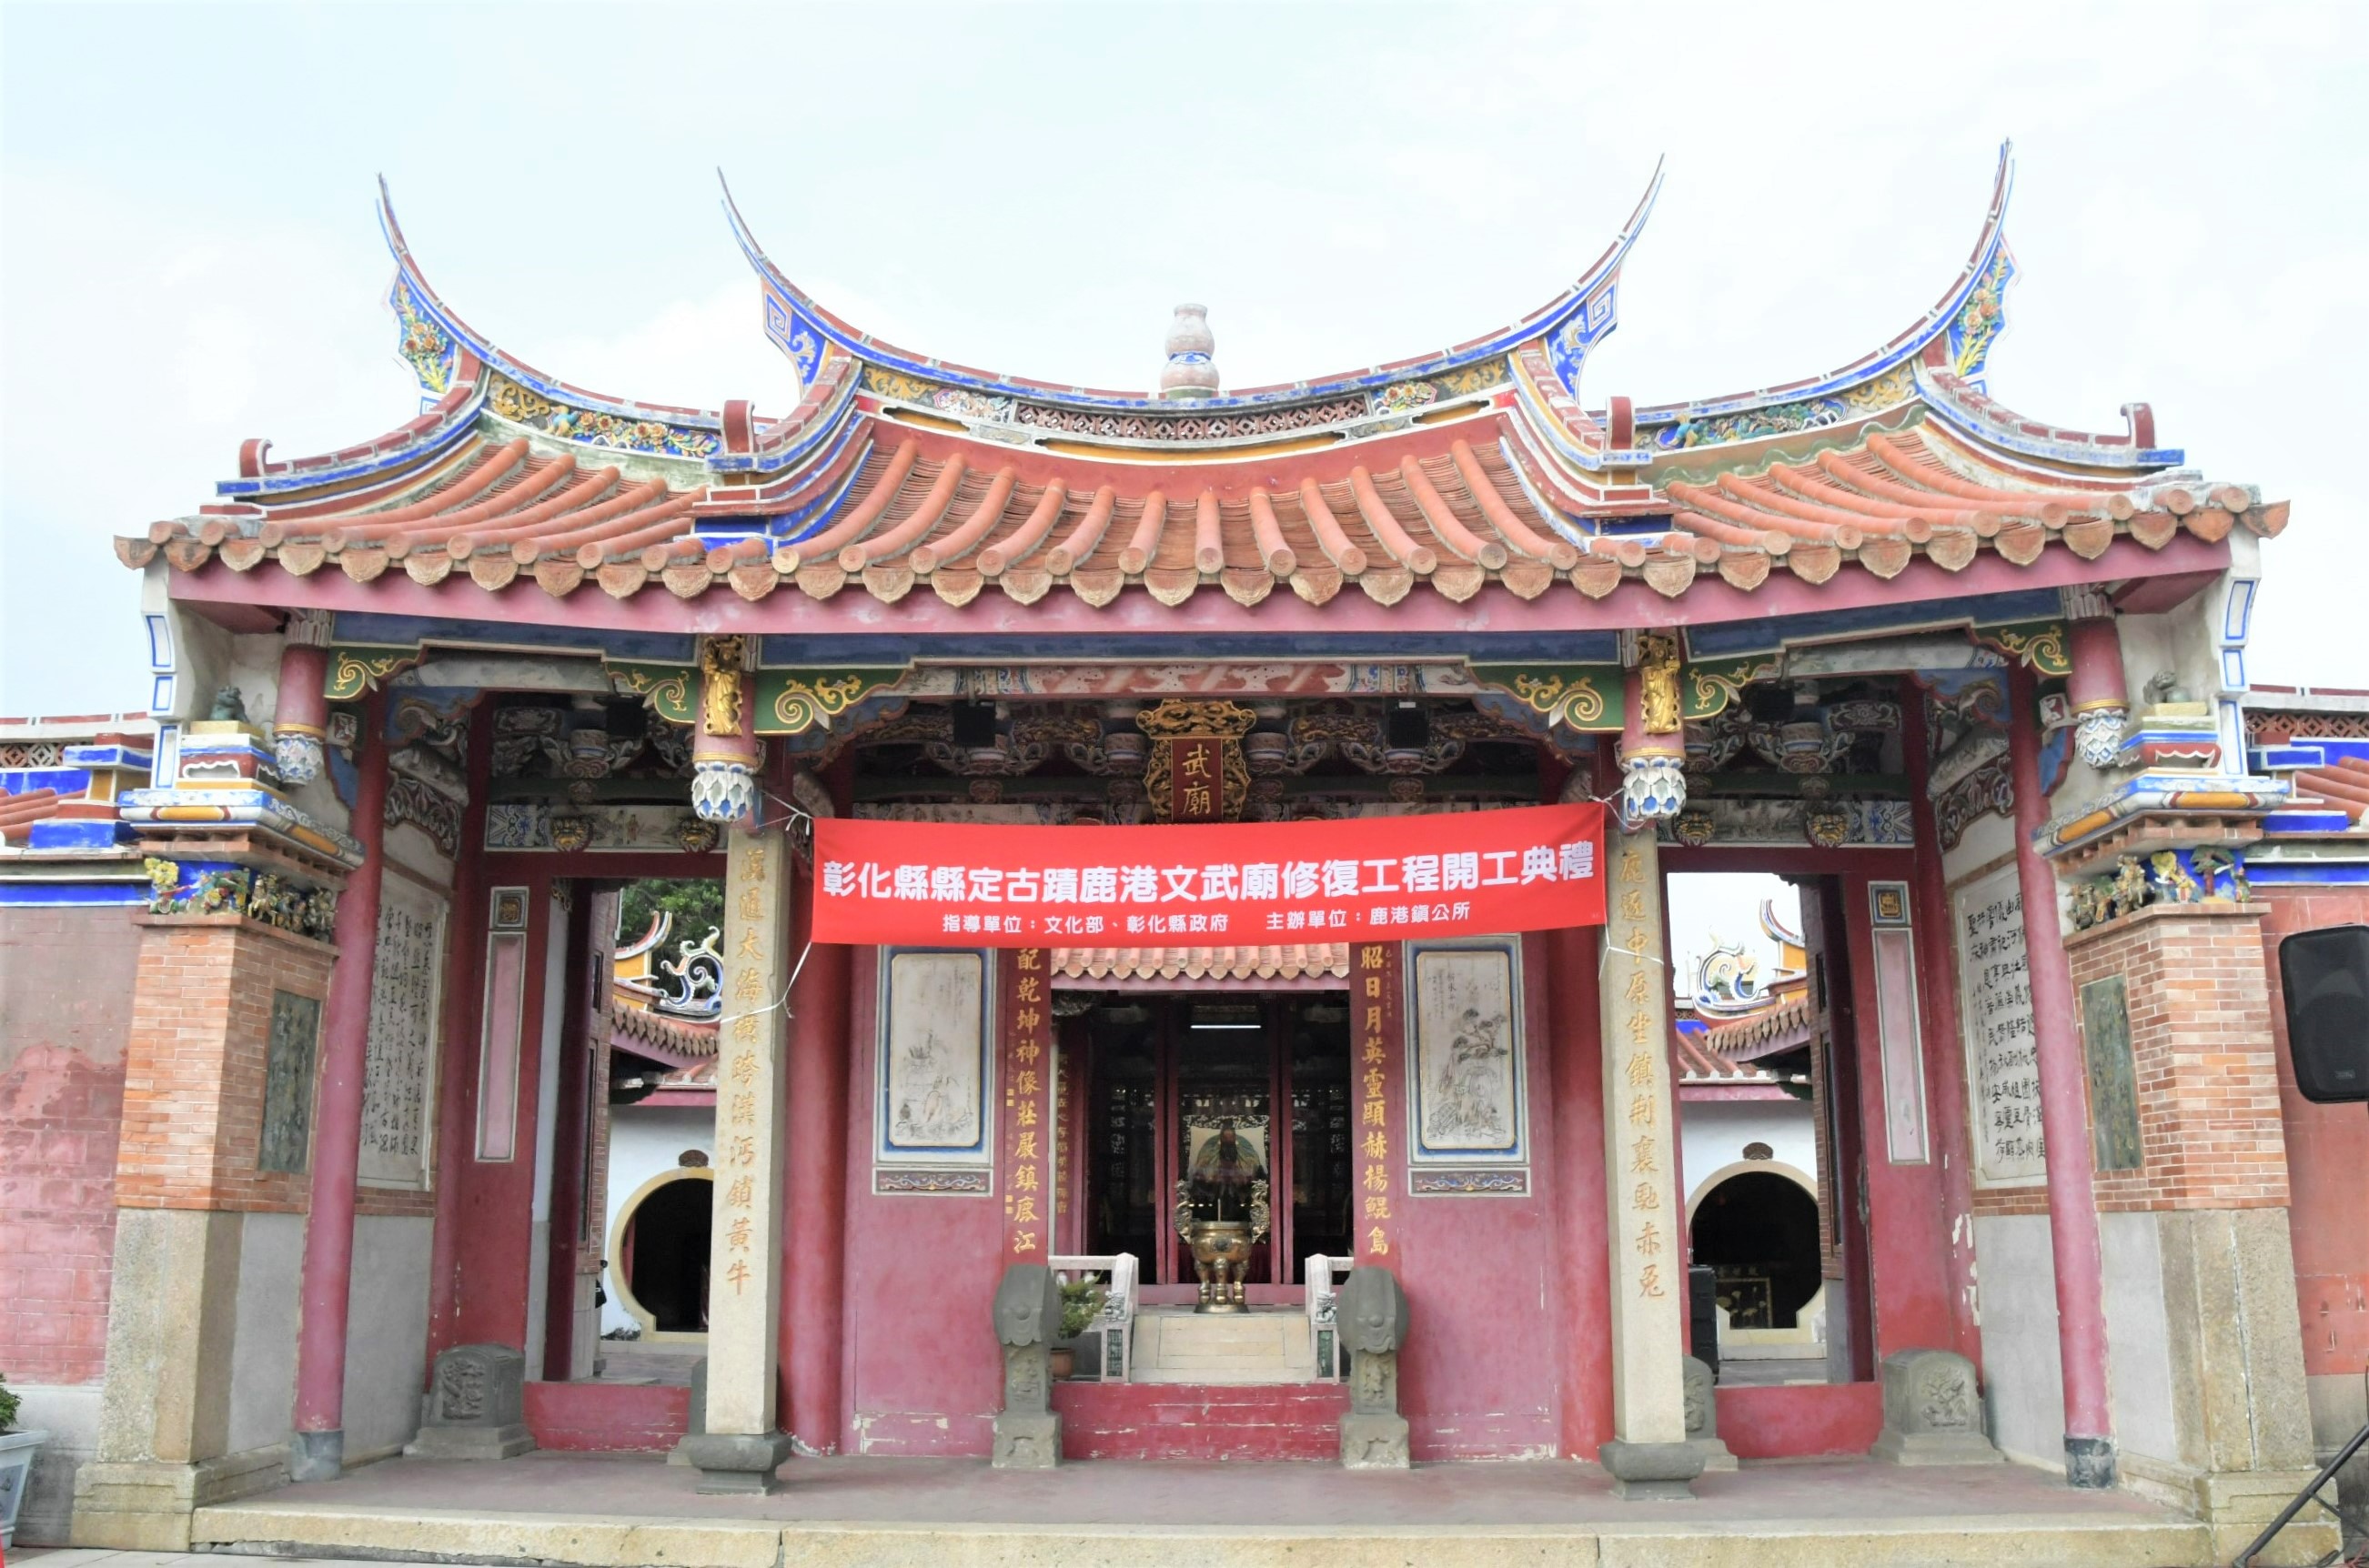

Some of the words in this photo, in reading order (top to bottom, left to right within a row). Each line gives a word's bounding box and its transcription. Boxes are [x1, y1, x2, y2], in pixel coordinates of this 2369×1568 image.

[1183, 743, 1212, 815] 武廟
[822, 840, 1595, 904] 彰化縣縣定古蹟鹿港文武廟修復工程開工典禮
